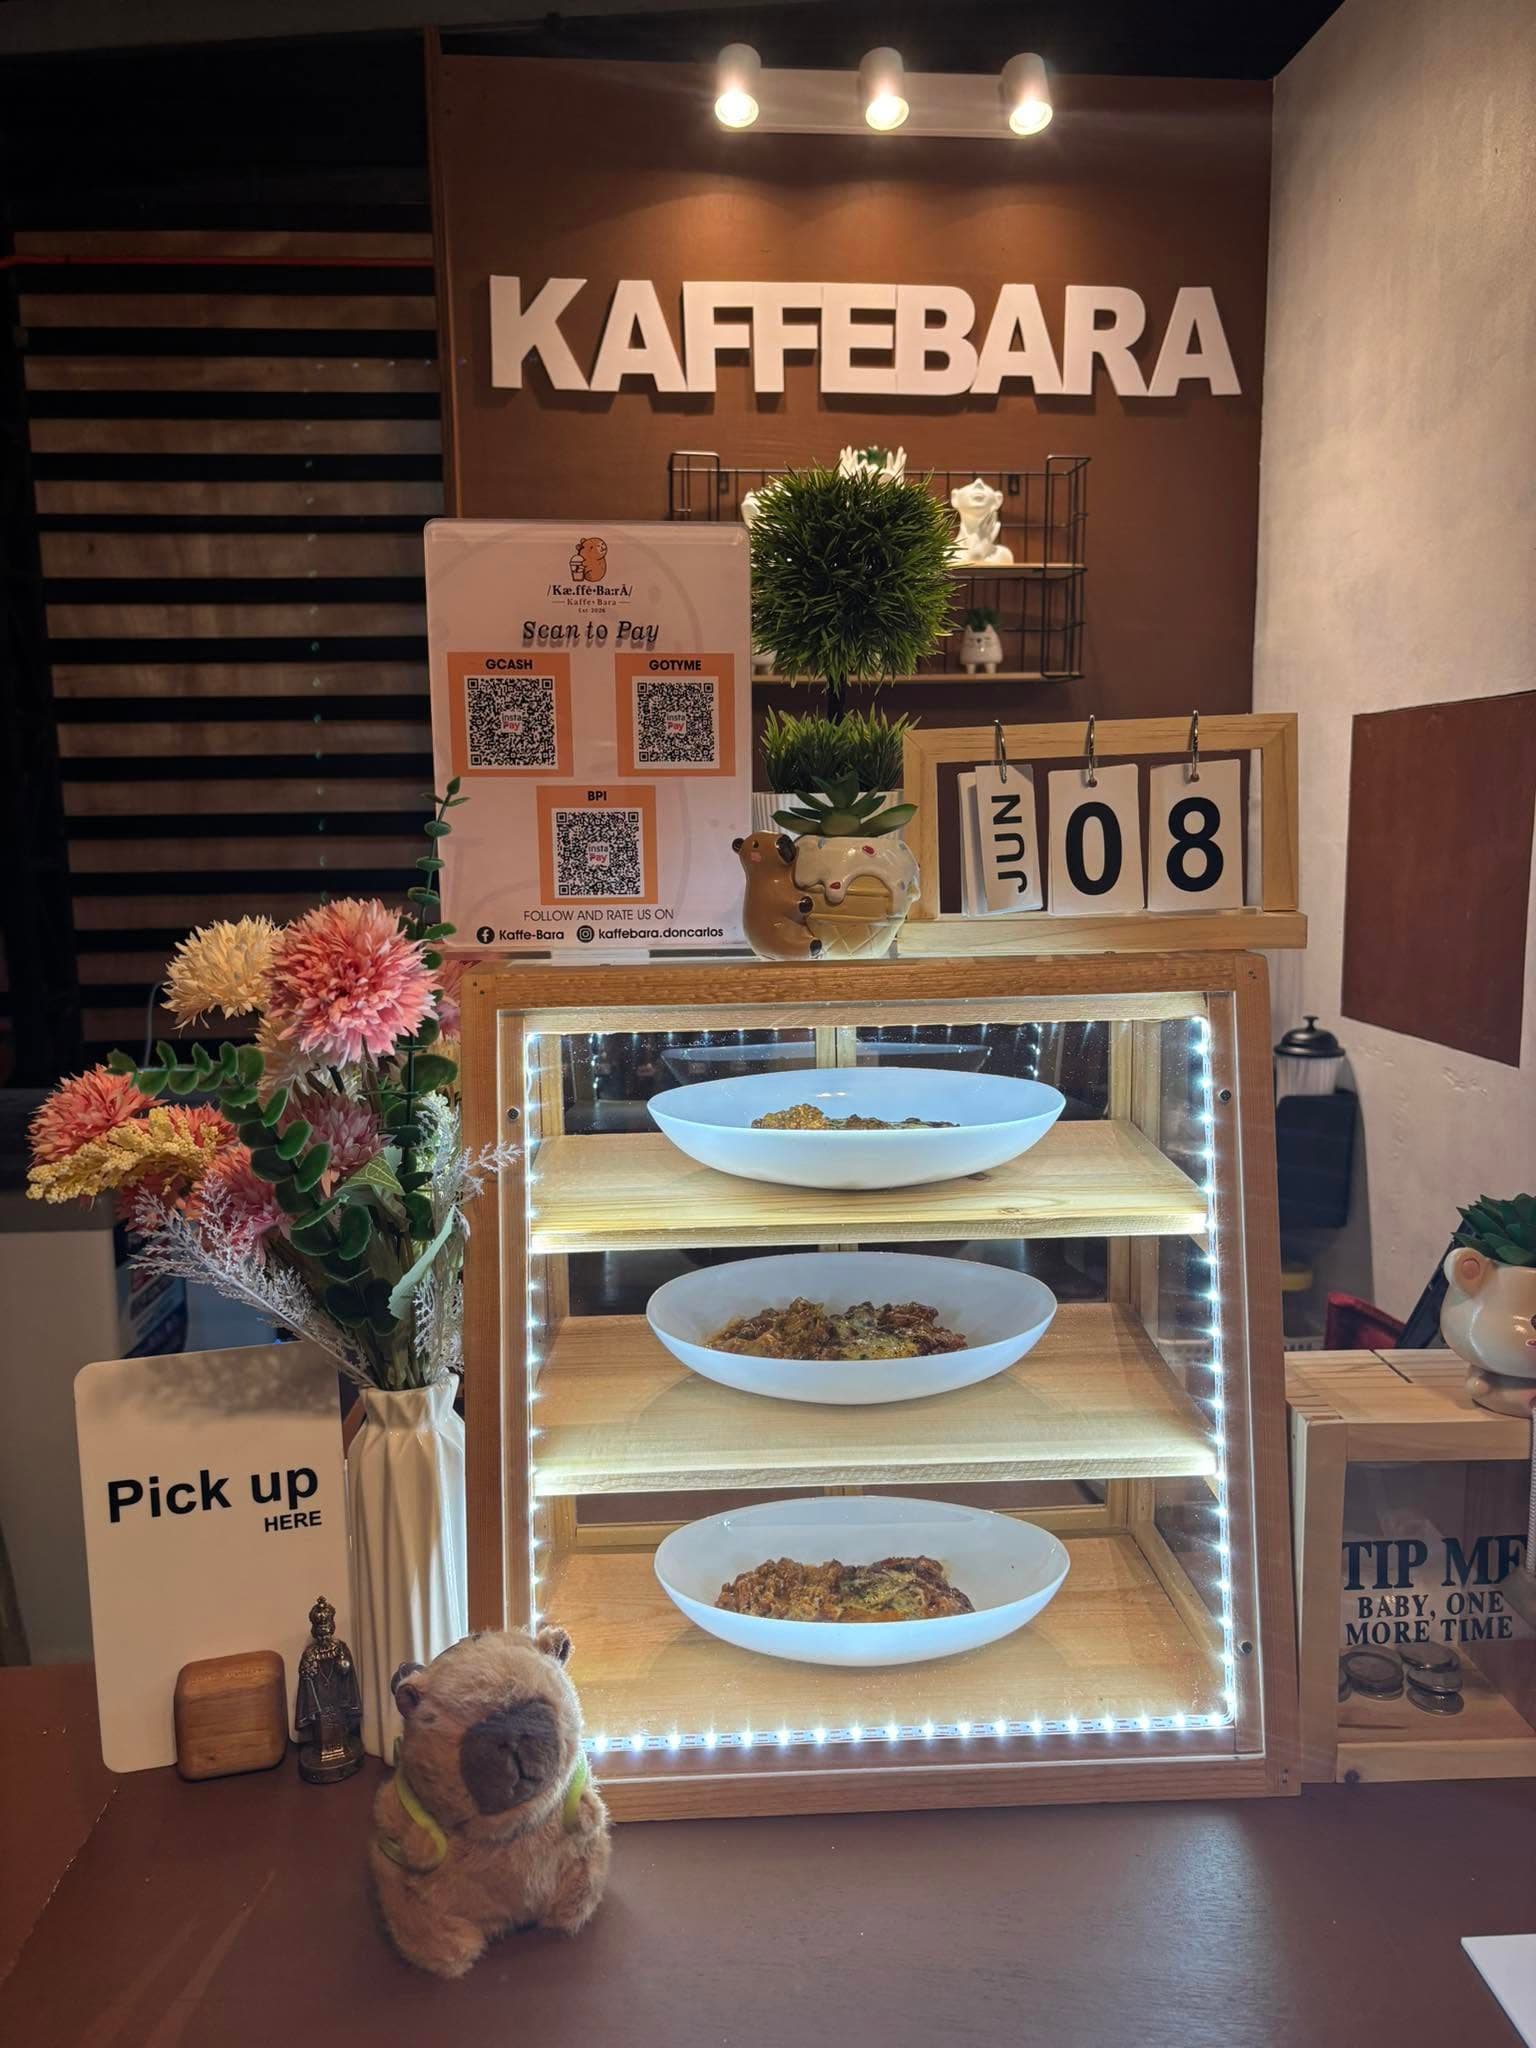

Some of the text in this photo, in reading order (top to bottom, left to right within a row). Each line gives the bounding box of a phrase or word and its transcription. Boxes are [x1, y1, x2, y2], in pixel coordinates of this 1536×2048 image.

[489, 274, 1242, 397] KAFFEBARA
[522, 620, 659, 645] Scan to Pay
[485, 659, 533, 670] GCASH
[649, 659, 701, 671] GOTYME
[503, 721, 519, 731] Pay
[667, 721, 684, 732] Pay
[587, 790, 607, 801] BPI
[991, 794, 1027, 893] JUN
[589, 853, 608, 863] Pay
[523, 909, 674, 922] FOLLOW AND RATE US ON
[499, 929, 564, 941] Kaffe-Bara
[598, 926, 724, 940] kaffebara.doncarlos
[107, 1465, 319, 1523] Pick up
[263, 1510, 322, 1532] HERE
[1342, 1539, 1428, 1590] TIP
[1357, 1590, 1504, 1621] BABY, ONE
[1345, 1615, 1513, 1646] MORE TIME
